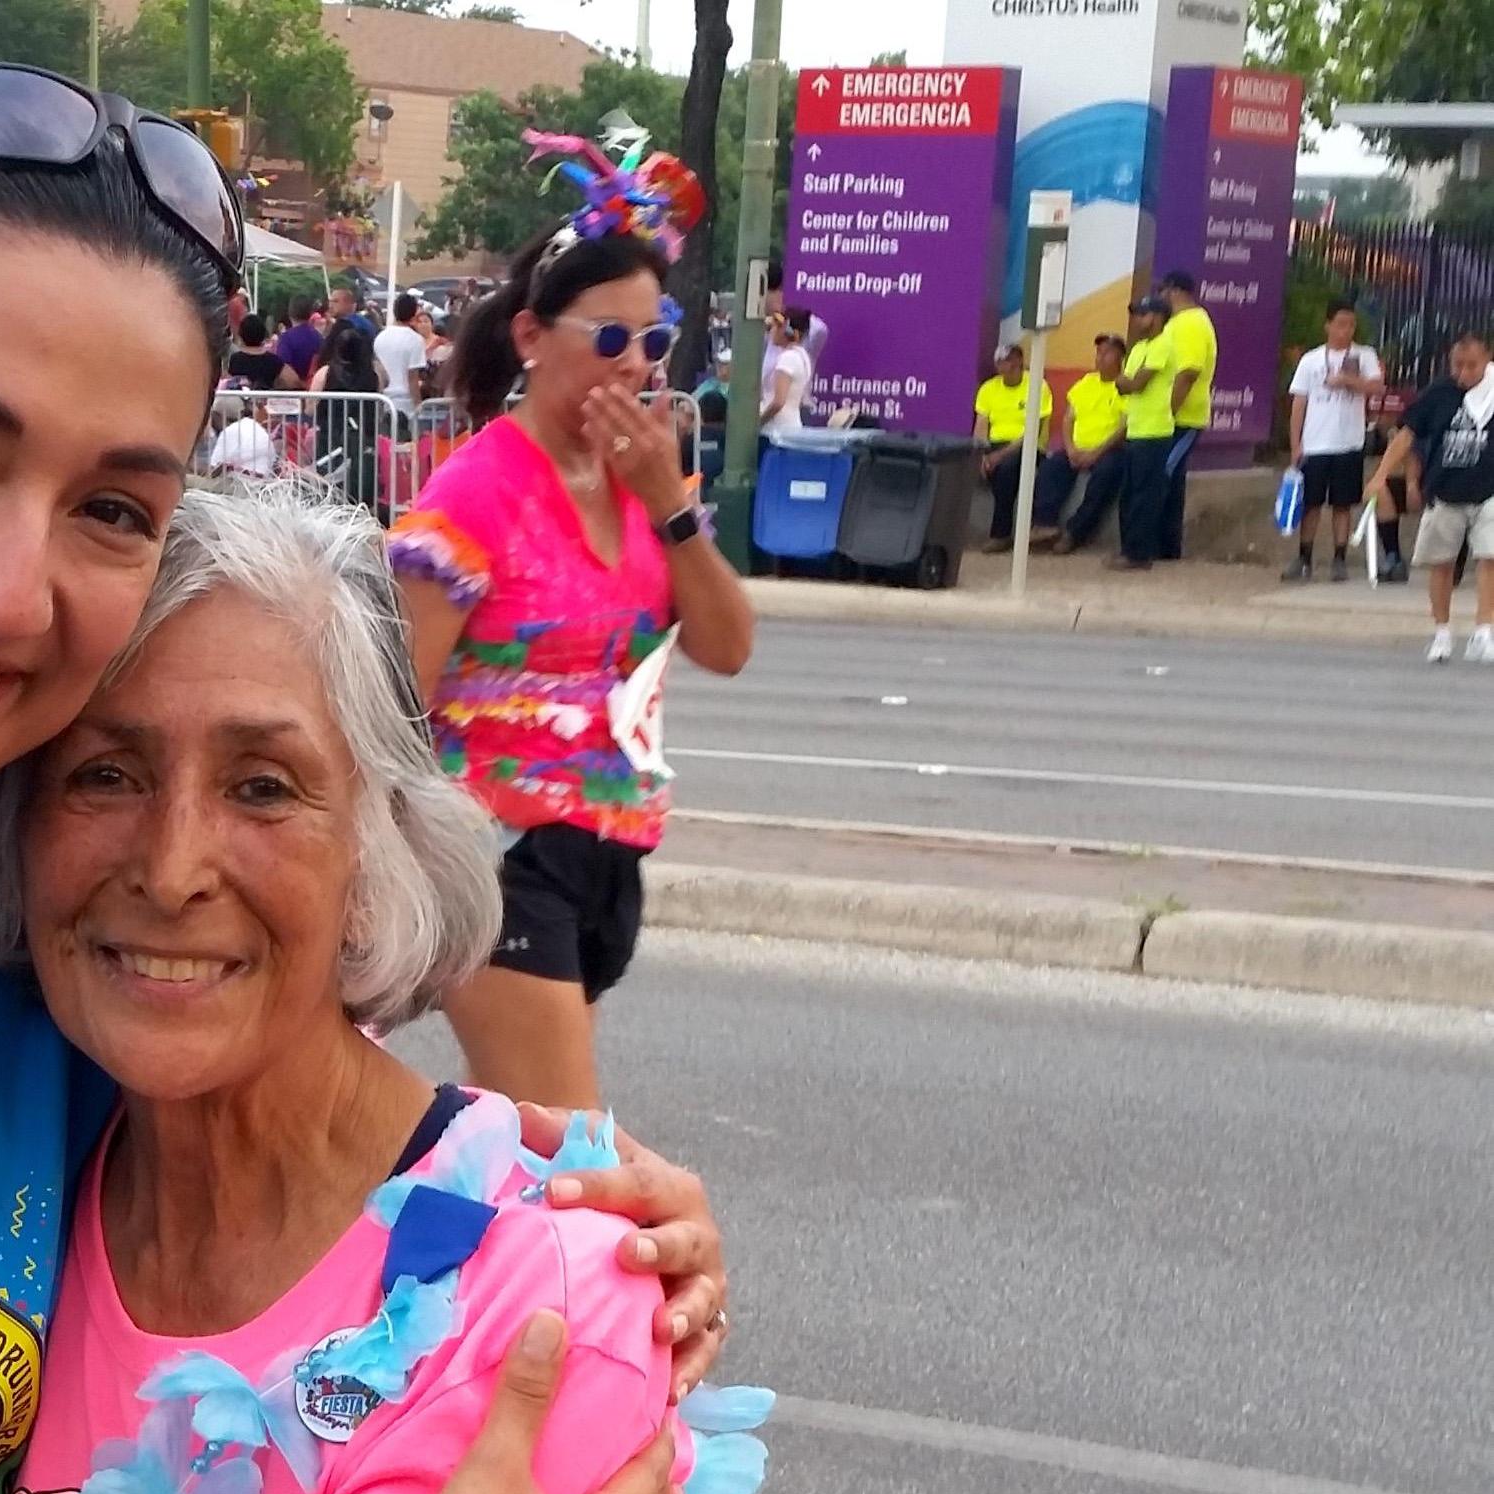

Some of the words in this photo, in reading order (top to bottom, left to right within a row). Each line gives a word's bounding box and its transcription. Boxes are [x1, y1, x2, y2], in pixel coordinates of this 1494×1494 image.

[991, 0, 1079, 16] CHRISTUS
[1083, 0, 1140, 15] Health
[842, 72, 968, 97] EMERGENCY
[839, 102, 972, 127] EMERGENCIA
[803, 173, 841, 194] Staff
[843, 174, 905, 198] Parking
[802, 209, 854, 230] Center
[857, 210, 879, 231] for
[882, 211, 950, 232] Children
[800, 234, 829, 254] and
[832, 234, 900, 255] Families
[796, 271, 852, 292] Patient
[854, 272, 923, 297] Drop-Off
[832, 374, 902, 397] Entrance
[905, 376, 927, 397] On
[883, 398, 905, 420] St.
[320, 1394, 365, 1416] FIESTA
